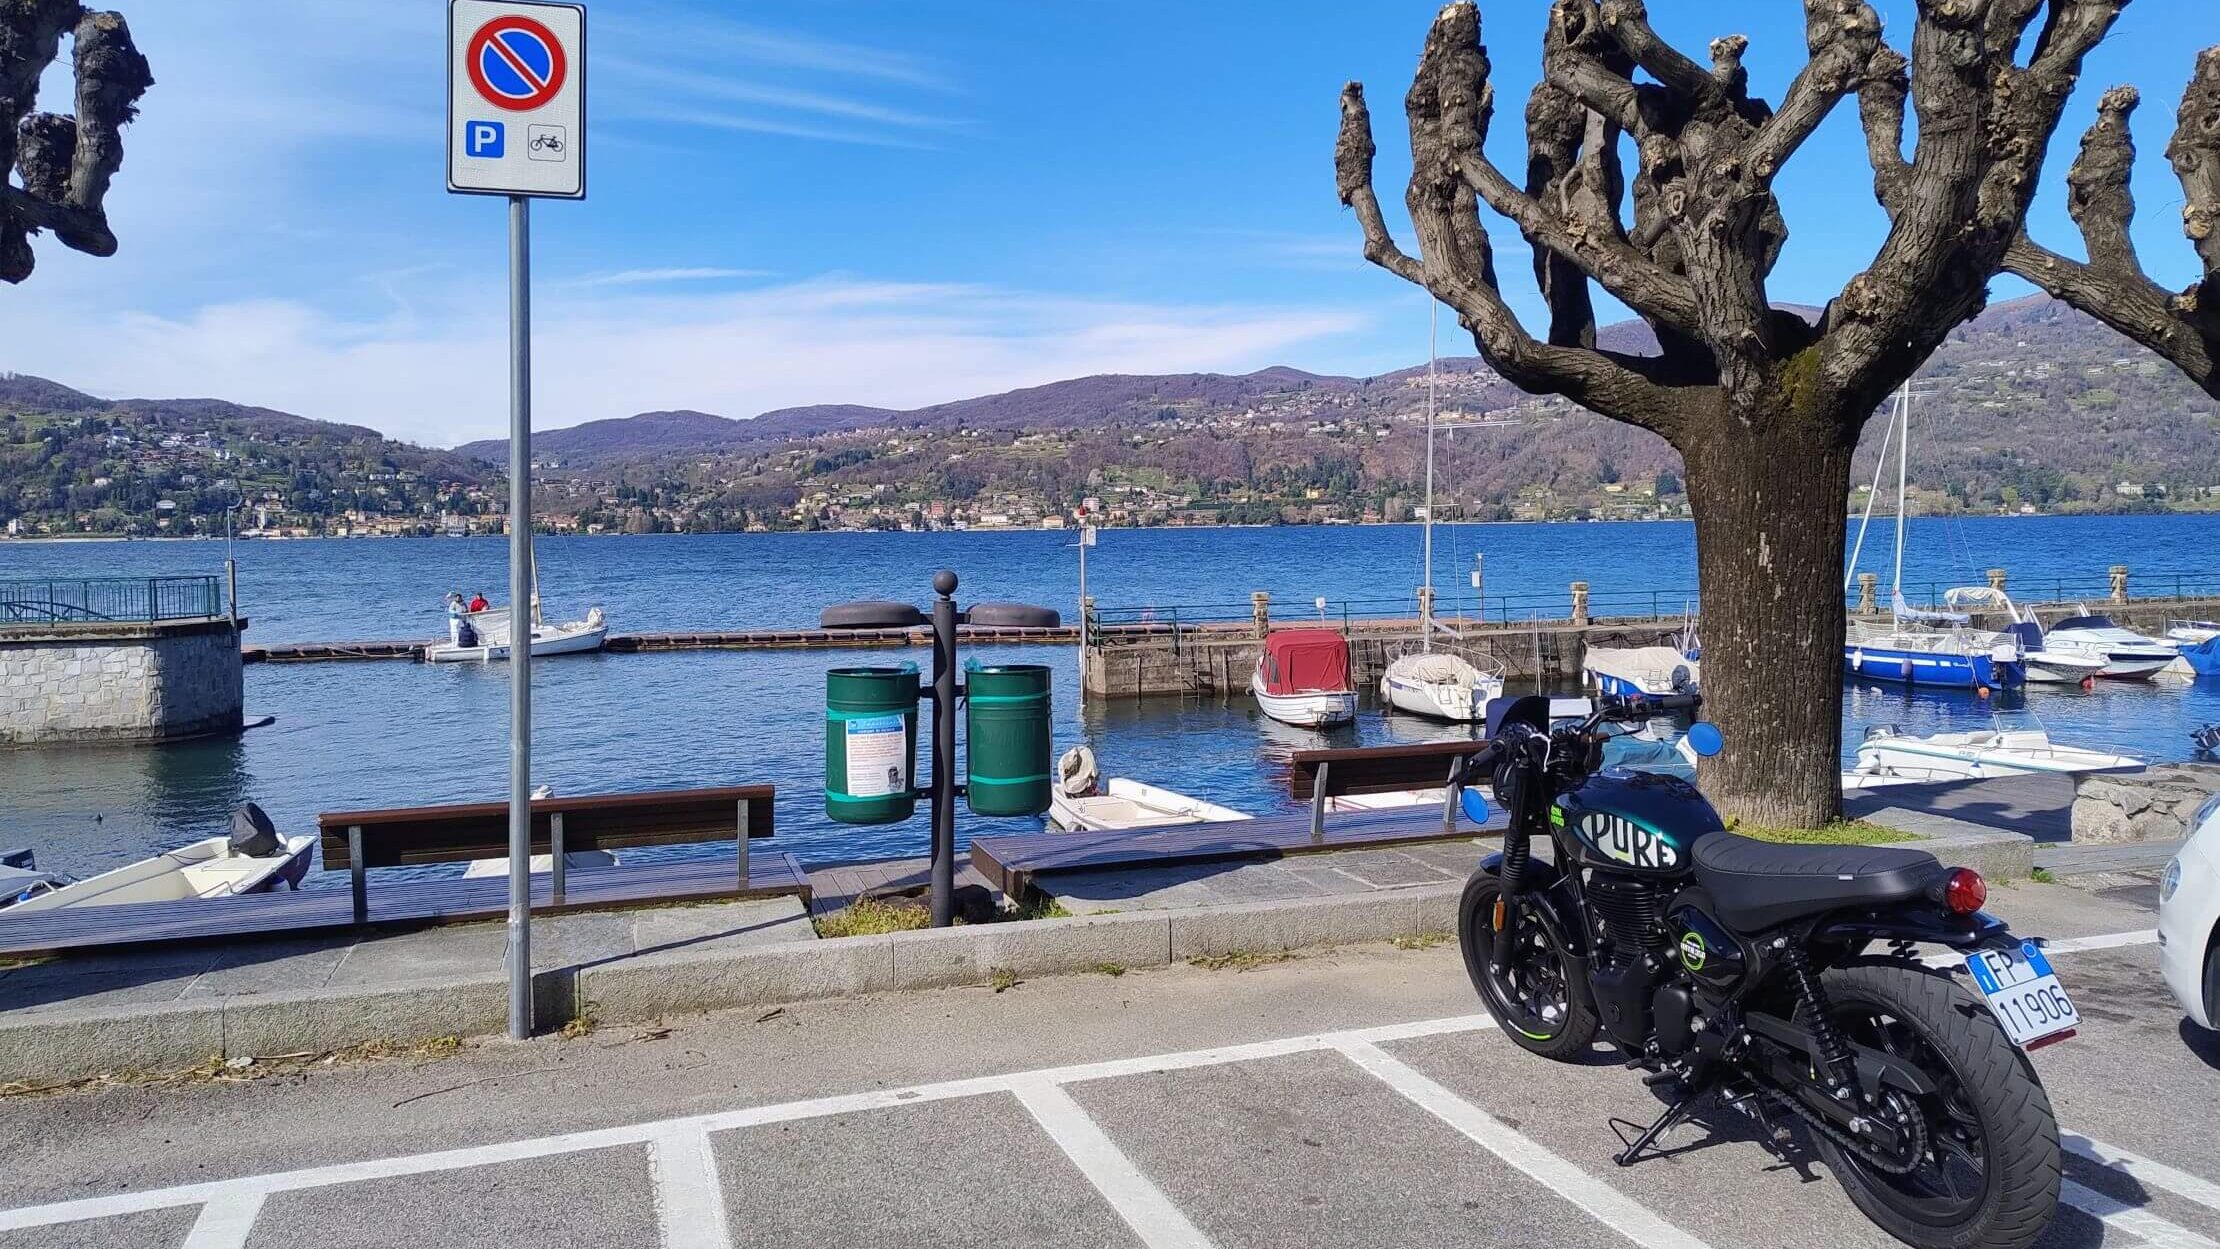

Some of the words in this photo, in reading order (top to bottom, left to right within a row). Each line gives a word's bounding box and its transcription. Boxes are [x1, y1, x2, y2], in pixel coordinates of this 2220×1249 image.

[475, 126, 496, 152] P
[1590, 812, 1673, 868] PURE
[1985, 951, 2016, 987] FP
[1999, 985, 2073, 1034] 11906
